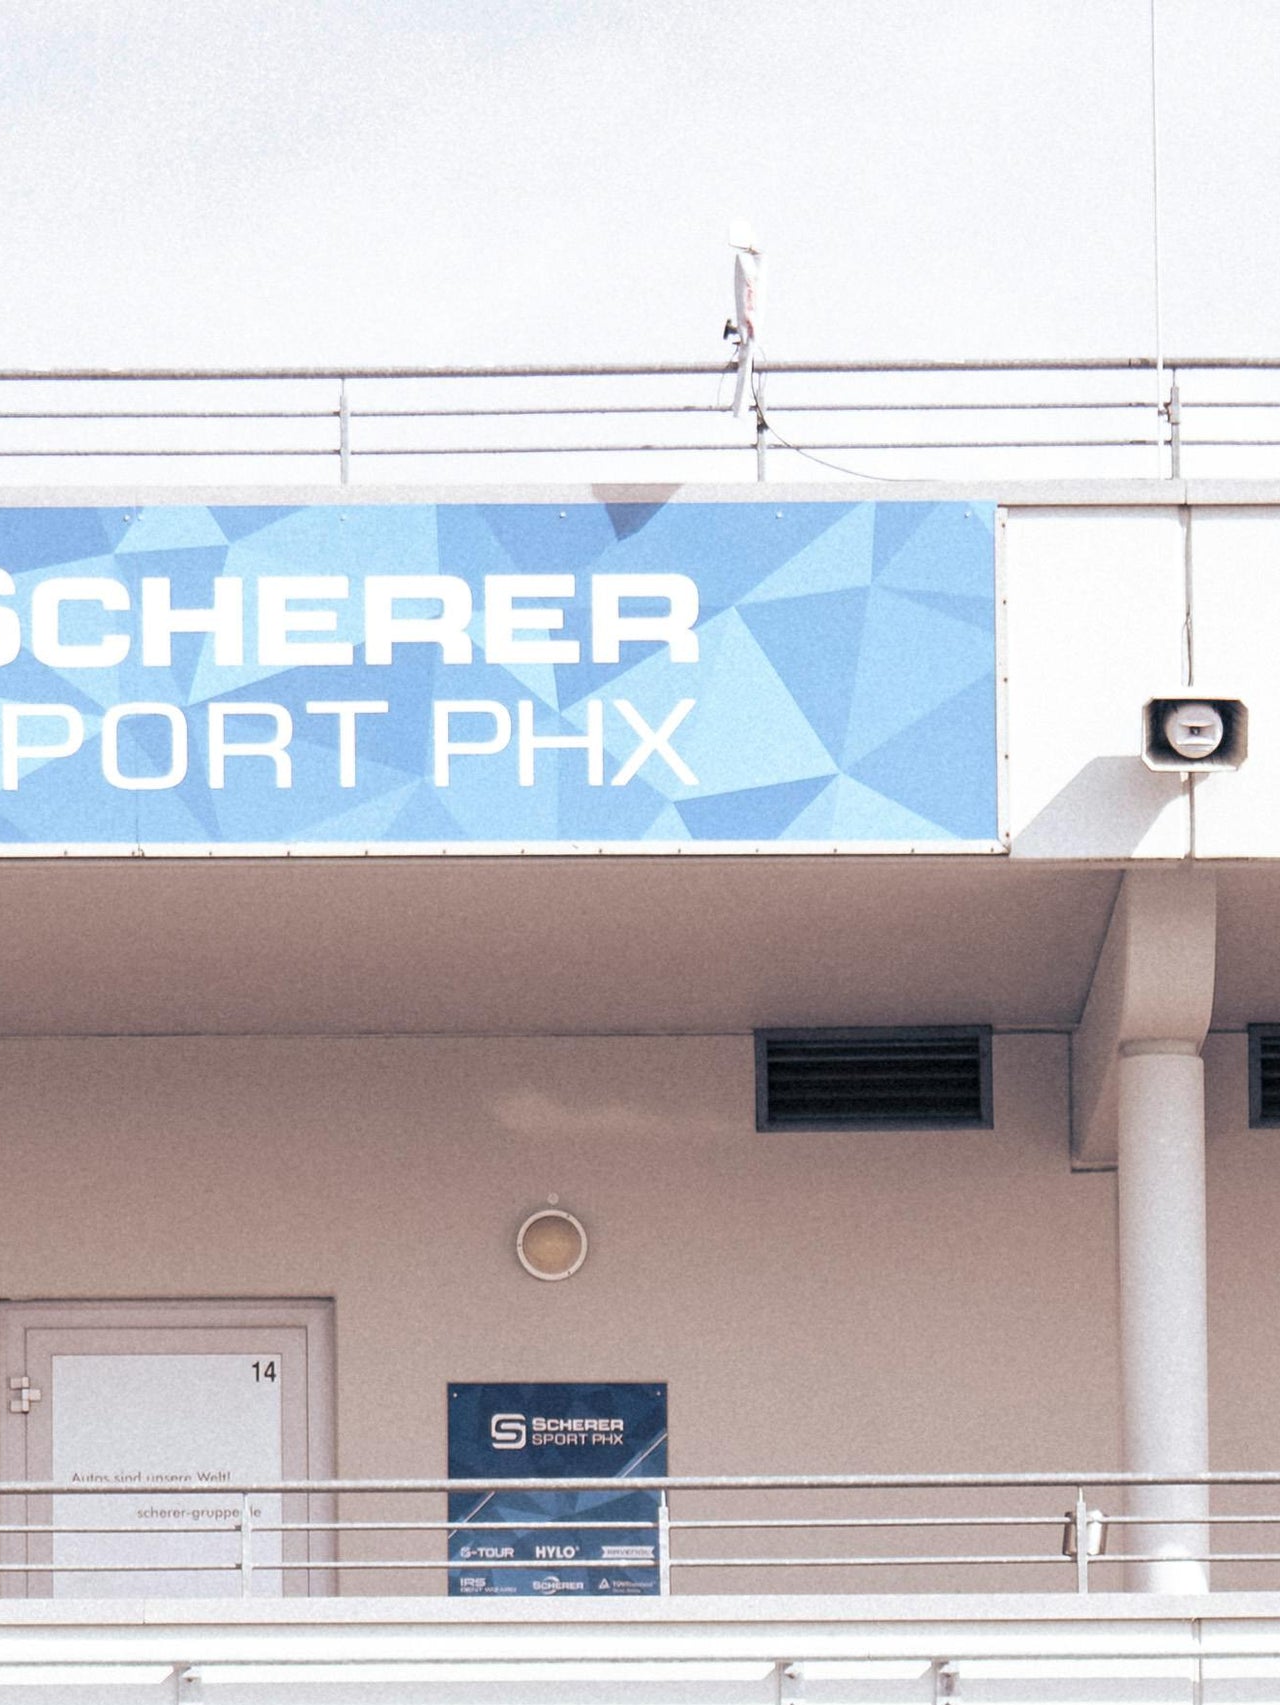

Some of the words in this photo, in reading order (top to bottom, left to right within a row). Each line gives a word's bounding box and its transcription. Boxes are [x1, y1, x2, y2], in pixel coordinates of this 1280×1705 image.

[434, 697, 699, 787] PHX
[252, 1360, 277, 1382] 14
[531, 1417, 624, 1431] SCHERER
[531, 1433, 587, 1445] SPORT
[591, 1433, 623, 1445] PHX
[535, 1545, 576, 1559] HYLO
